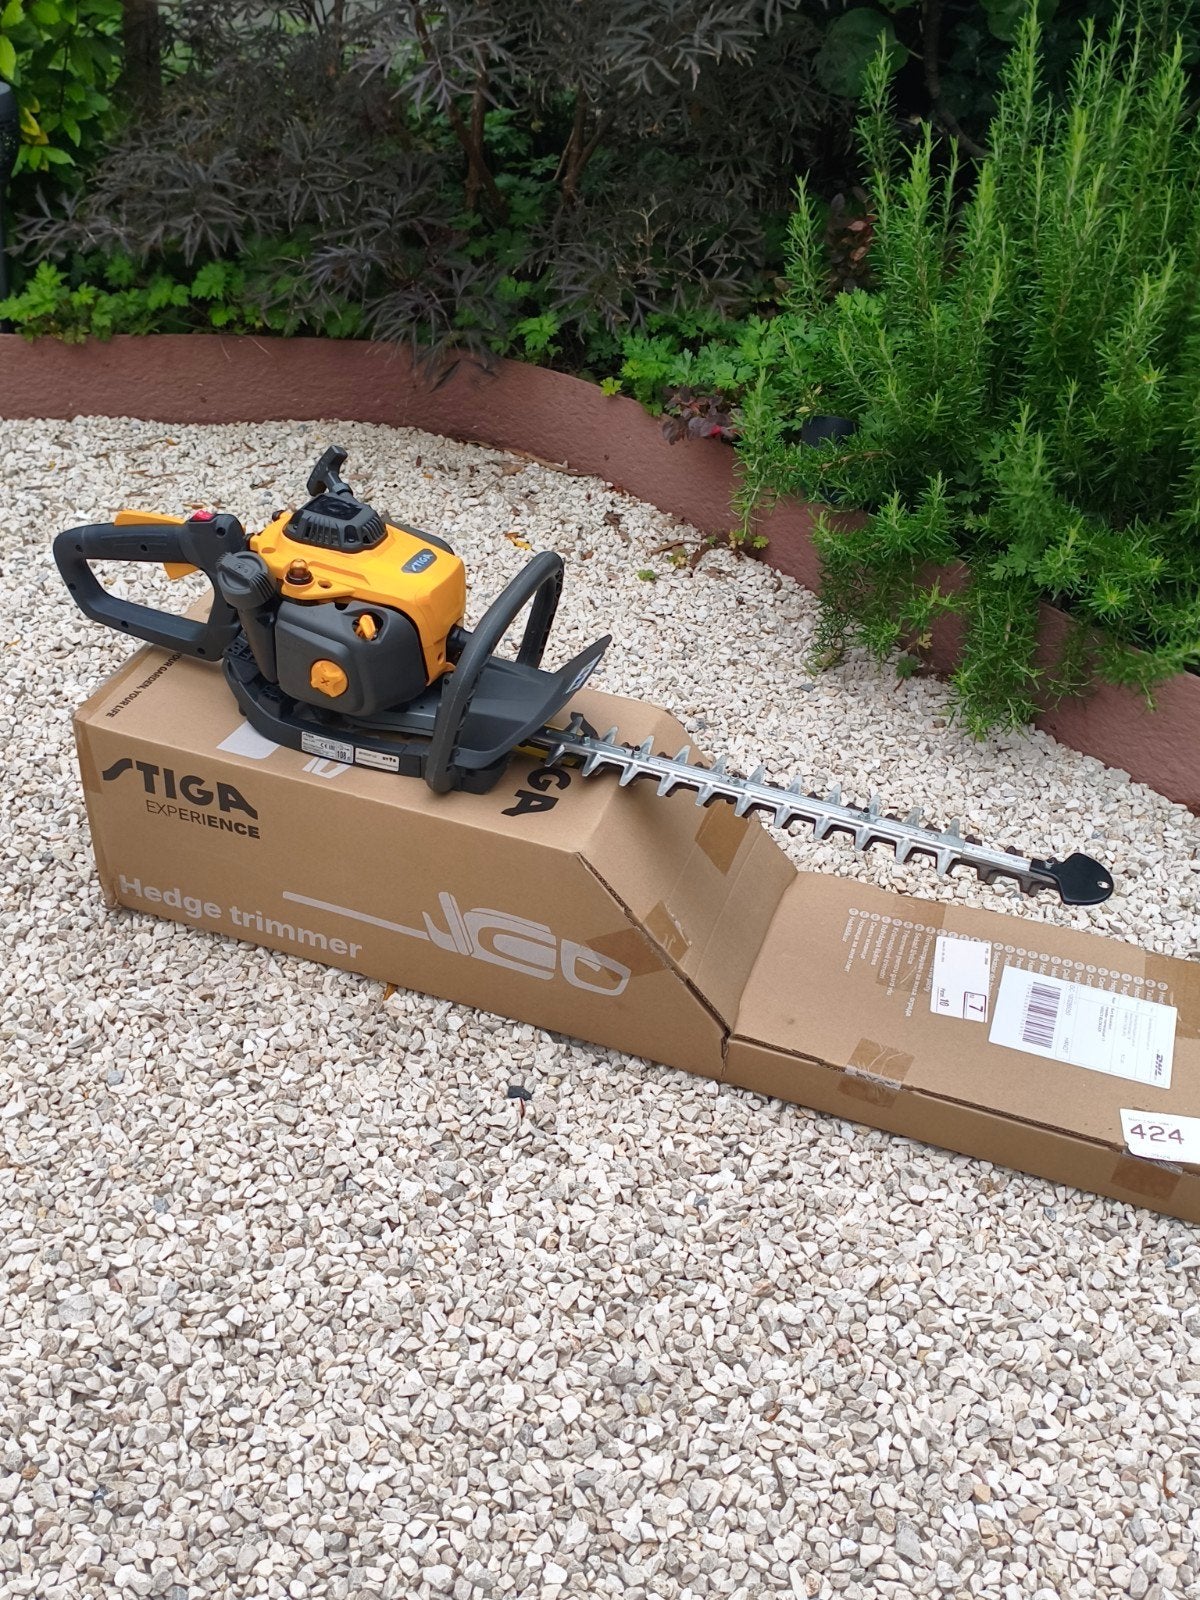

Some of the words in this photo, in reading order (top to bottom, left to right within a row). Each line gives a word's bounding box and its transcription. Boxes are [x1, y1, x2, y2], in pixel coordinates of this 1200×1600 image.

[411, 553, 433, 571] STIGA
[164, 653, 182, 667] OUR
[136, 666, 168, 689] GARDEN,
[119, 690, 142, 706] YOUR
[105, 705, 125, 718] LIFE
[102, 757, 258, 820] STIGA
[145, 799, 260, 839] EXPERIENCE
[118, 873, 222, 919] Hedge
[229, 904, 363, 959] trimmer
[1152, 1053, 1165, 1076] DHL
[1130, 1123, 1185, 1145] 424
